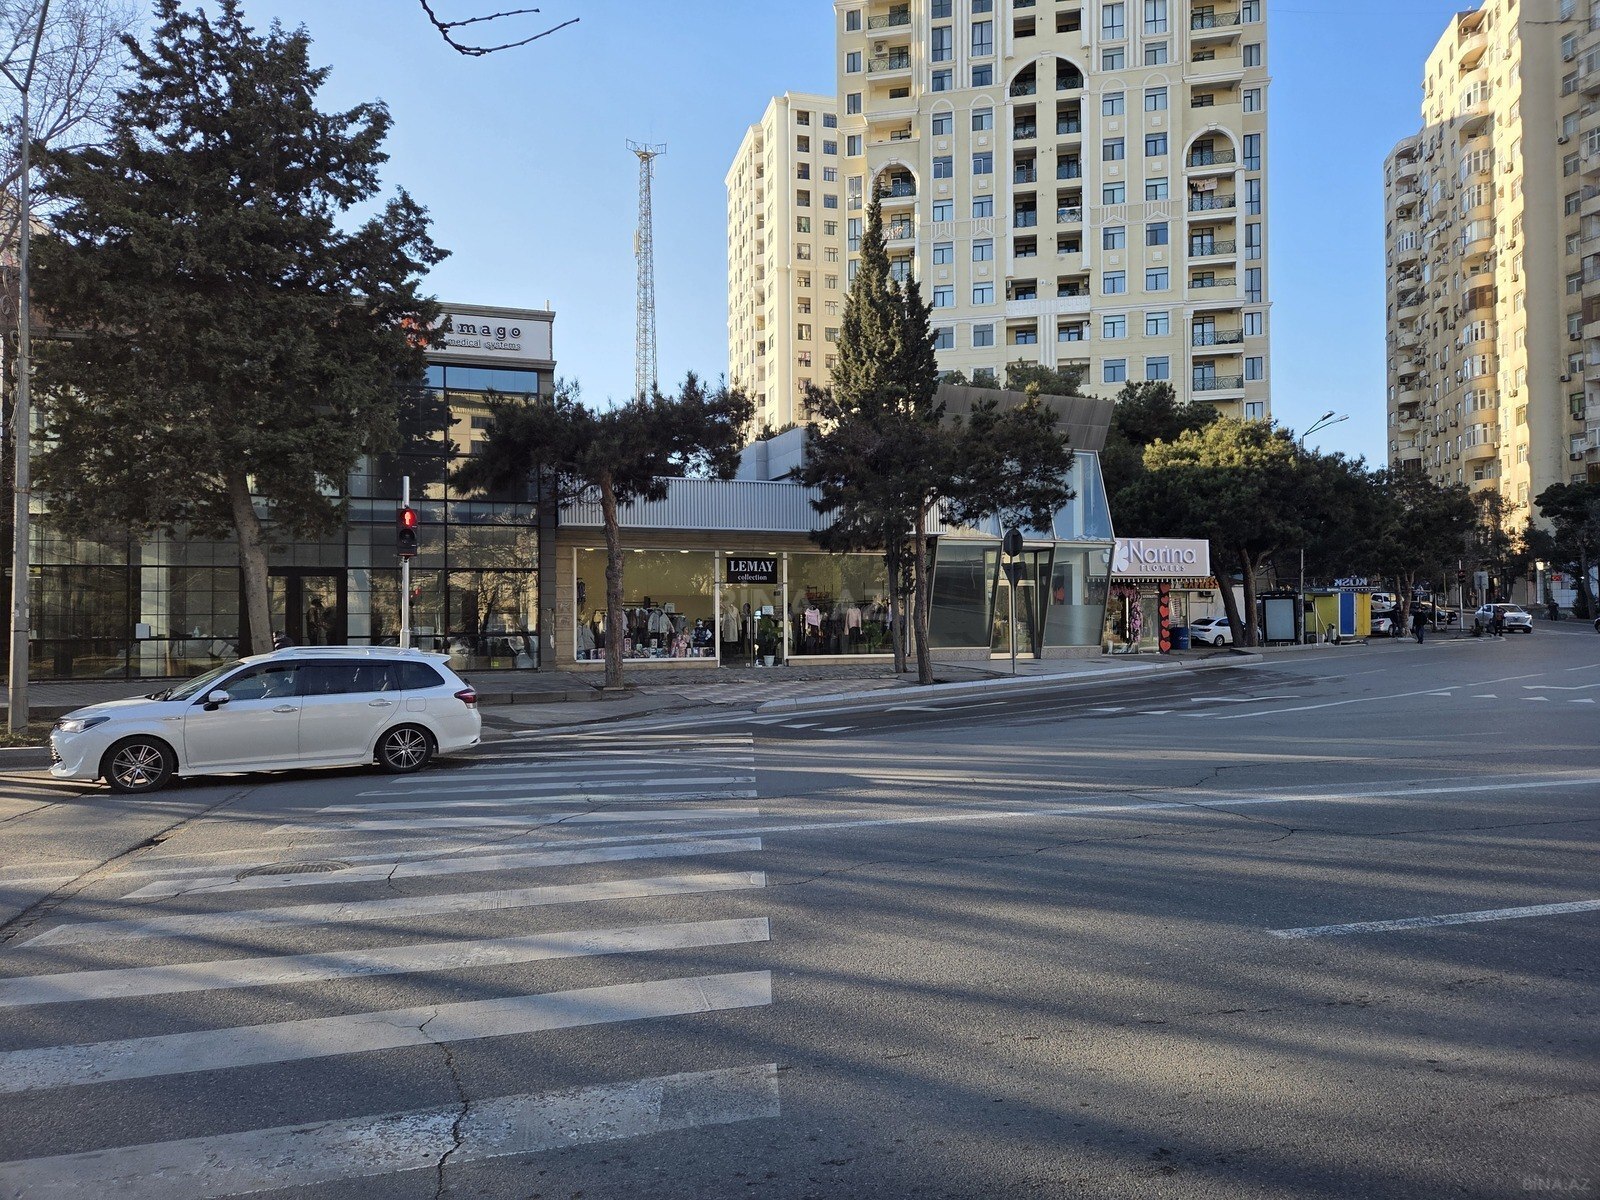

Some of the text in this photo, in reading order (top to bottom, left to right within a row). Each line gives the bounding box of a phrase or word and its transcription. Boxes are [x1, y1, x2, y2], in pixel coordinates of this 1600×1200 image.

[448, 339, 521, 351] medical systems
[1128, 540, 1197, 564] Narina
[730, 560, 774, 572] LEMAY
[737, 573, 767, 581] collection
